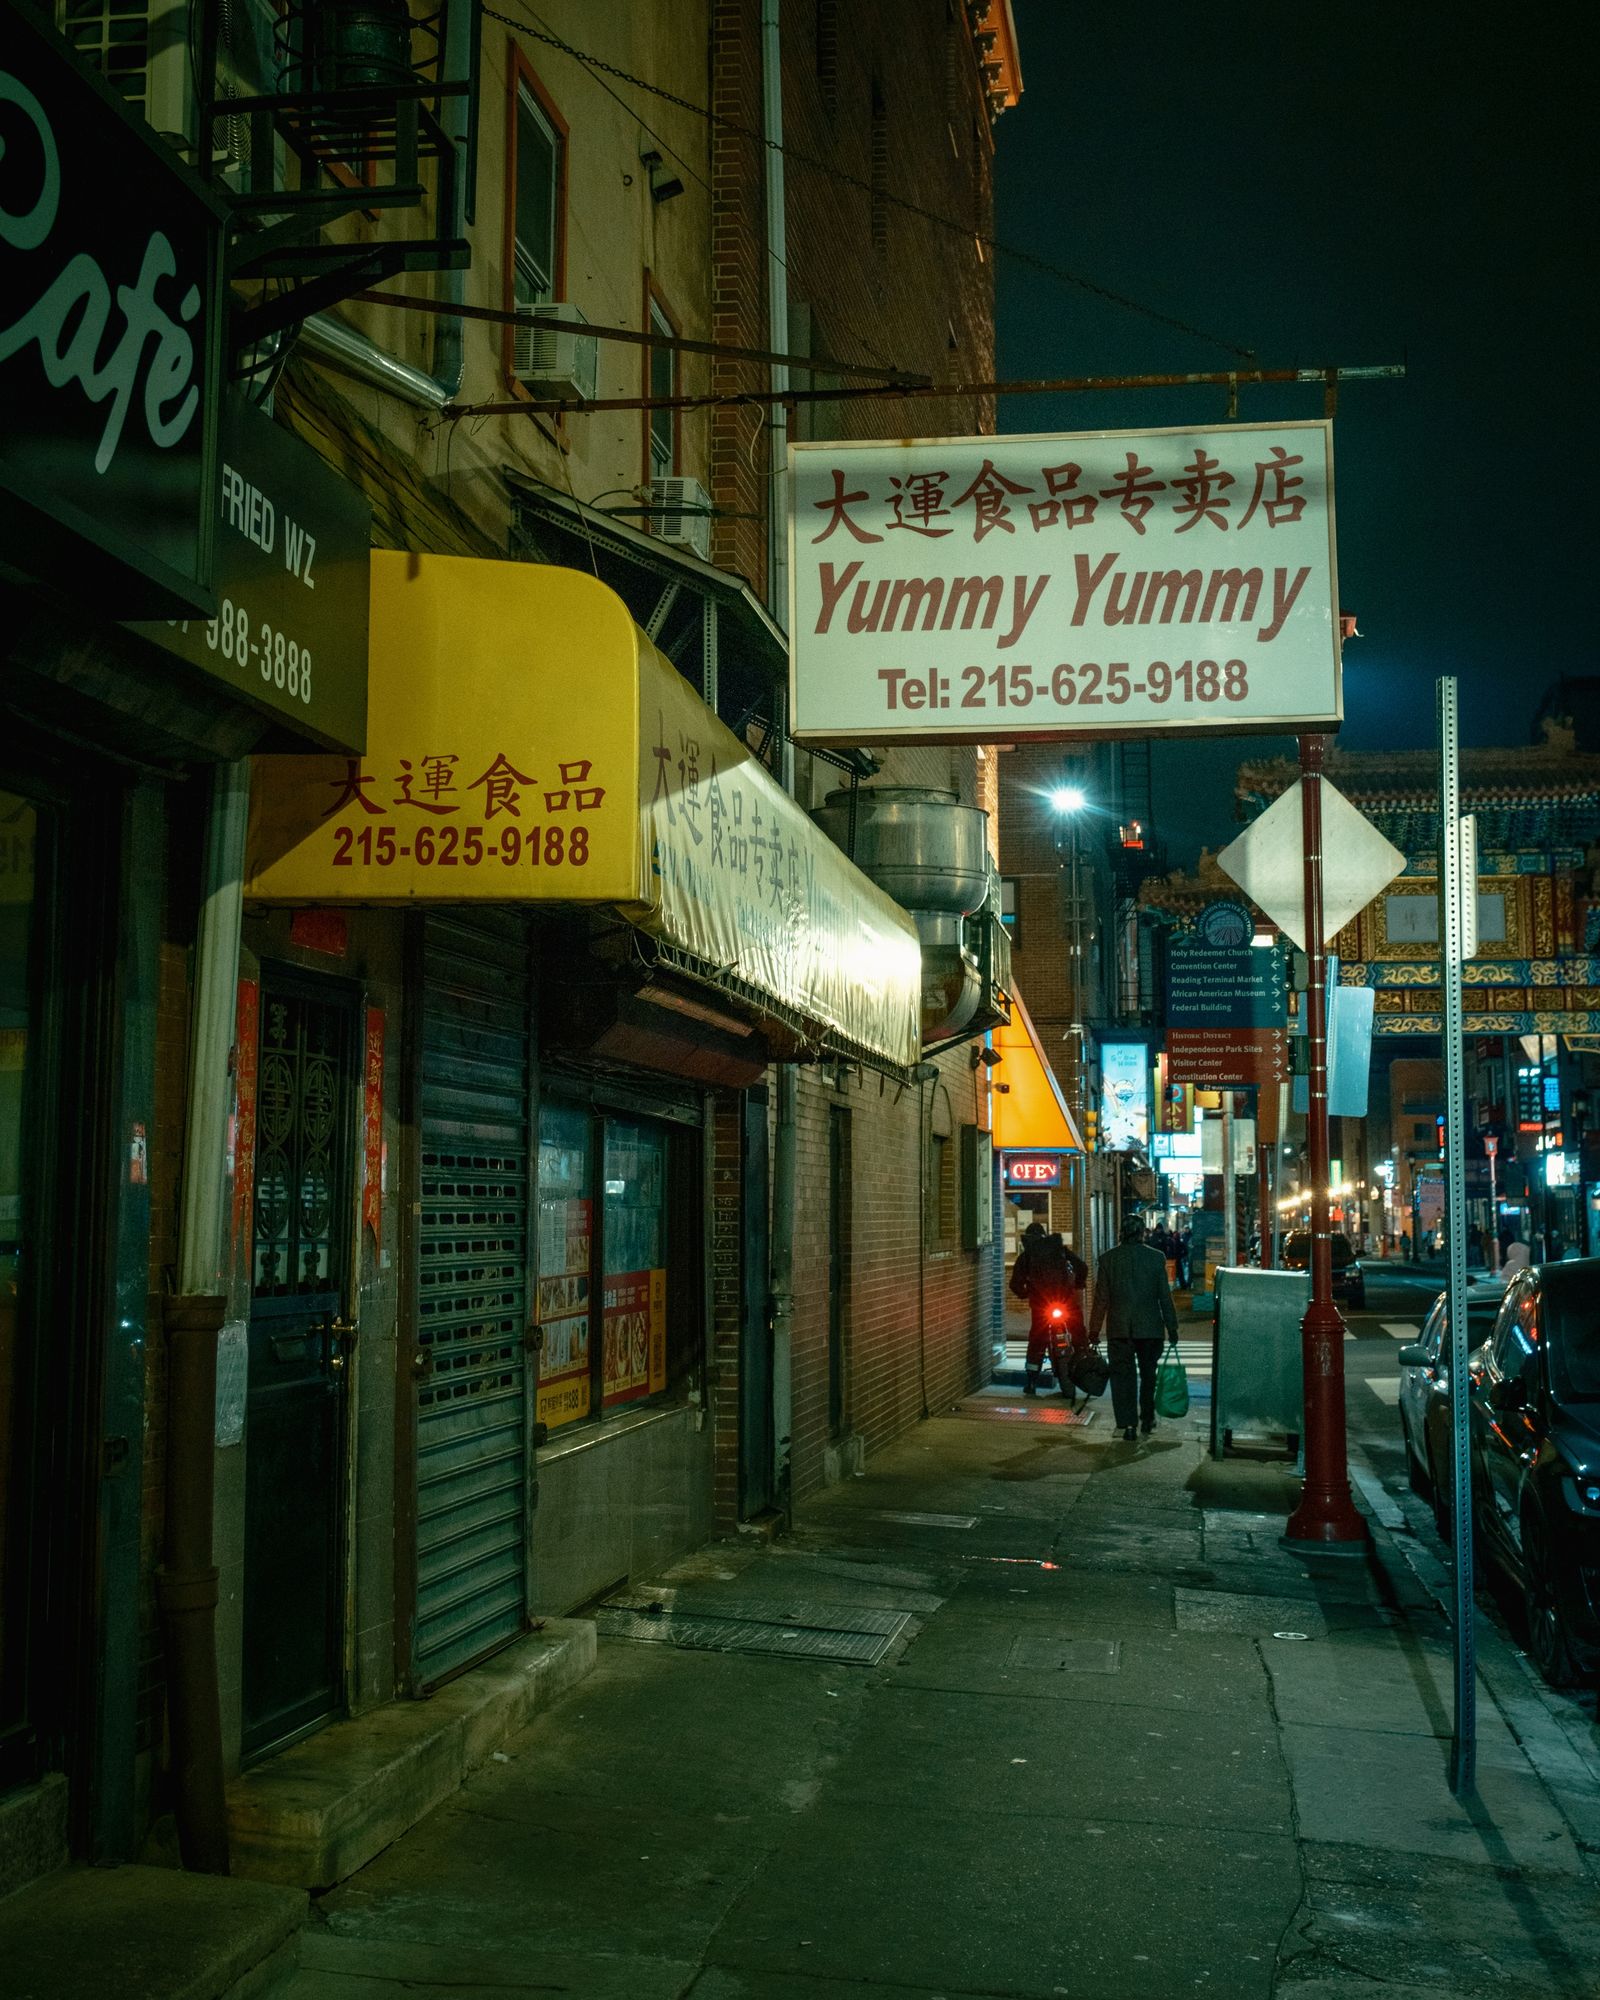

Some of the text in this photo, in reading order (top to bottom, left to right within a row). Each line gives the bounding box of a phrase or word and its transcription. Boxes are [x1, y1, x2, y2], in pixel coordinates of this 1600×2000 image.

[221, 463, 275, 554] FRIED
[811, 446, 1308, 544] 大運食品专卖店
[814, 553, 1312, 648] Yummy Yummy
[960, 658, 1249, 708] 215-625-9188
[321, 752, 606, 820] 大運食品
[332, 826, 590, 866] 215-625-9188
[1171, 949, 1253, 957] Holy Redeemer Church
[1171, 962, 1211, 970] Convention
[1171, 976, 1201, 985] Reading
[1237, 975, 1263, 983] Market
[1201, 1004, 1232, 1012] Building
[1172, 1045, 1263, 1054] Independence Park Sites
